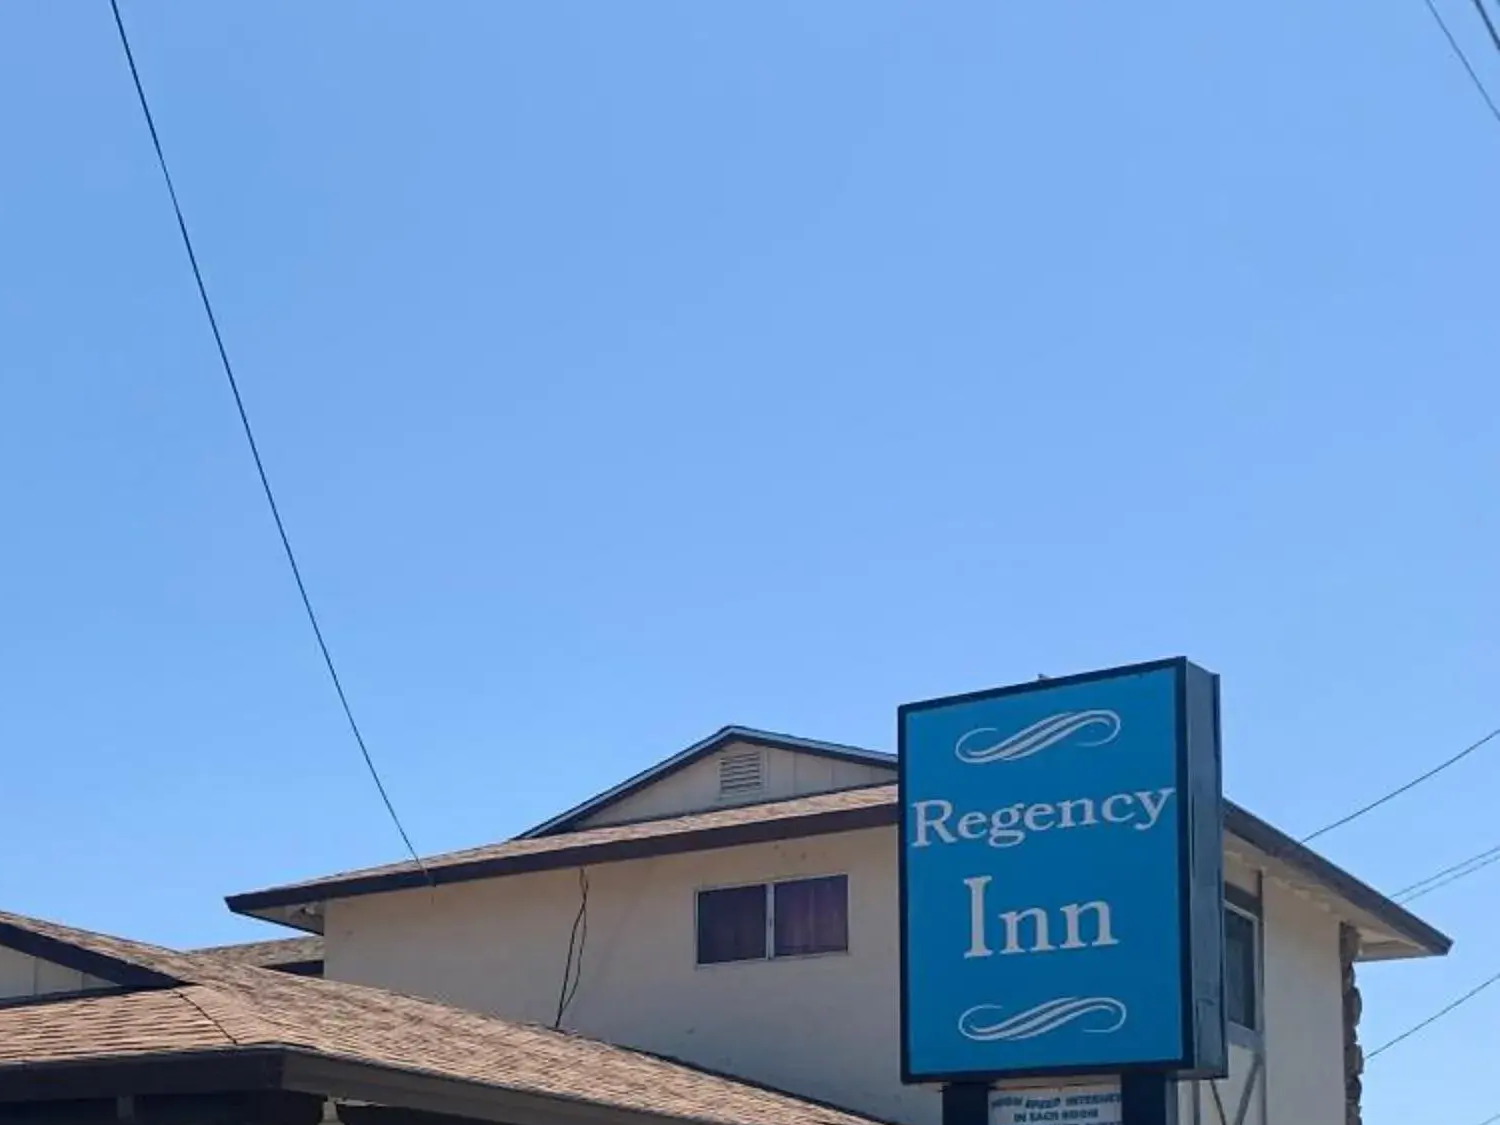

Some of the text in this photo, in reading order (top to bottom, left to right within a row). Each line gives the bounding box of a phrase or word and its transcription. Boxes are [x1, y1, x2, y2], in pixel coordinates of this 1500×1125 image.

[911, 786, 1176, 848] Regency
[963, 875, 1120, 959] Inn
[1014, 1110, 1029, 1122] IN
[1030, 1109, 1059, 1121] EACH
